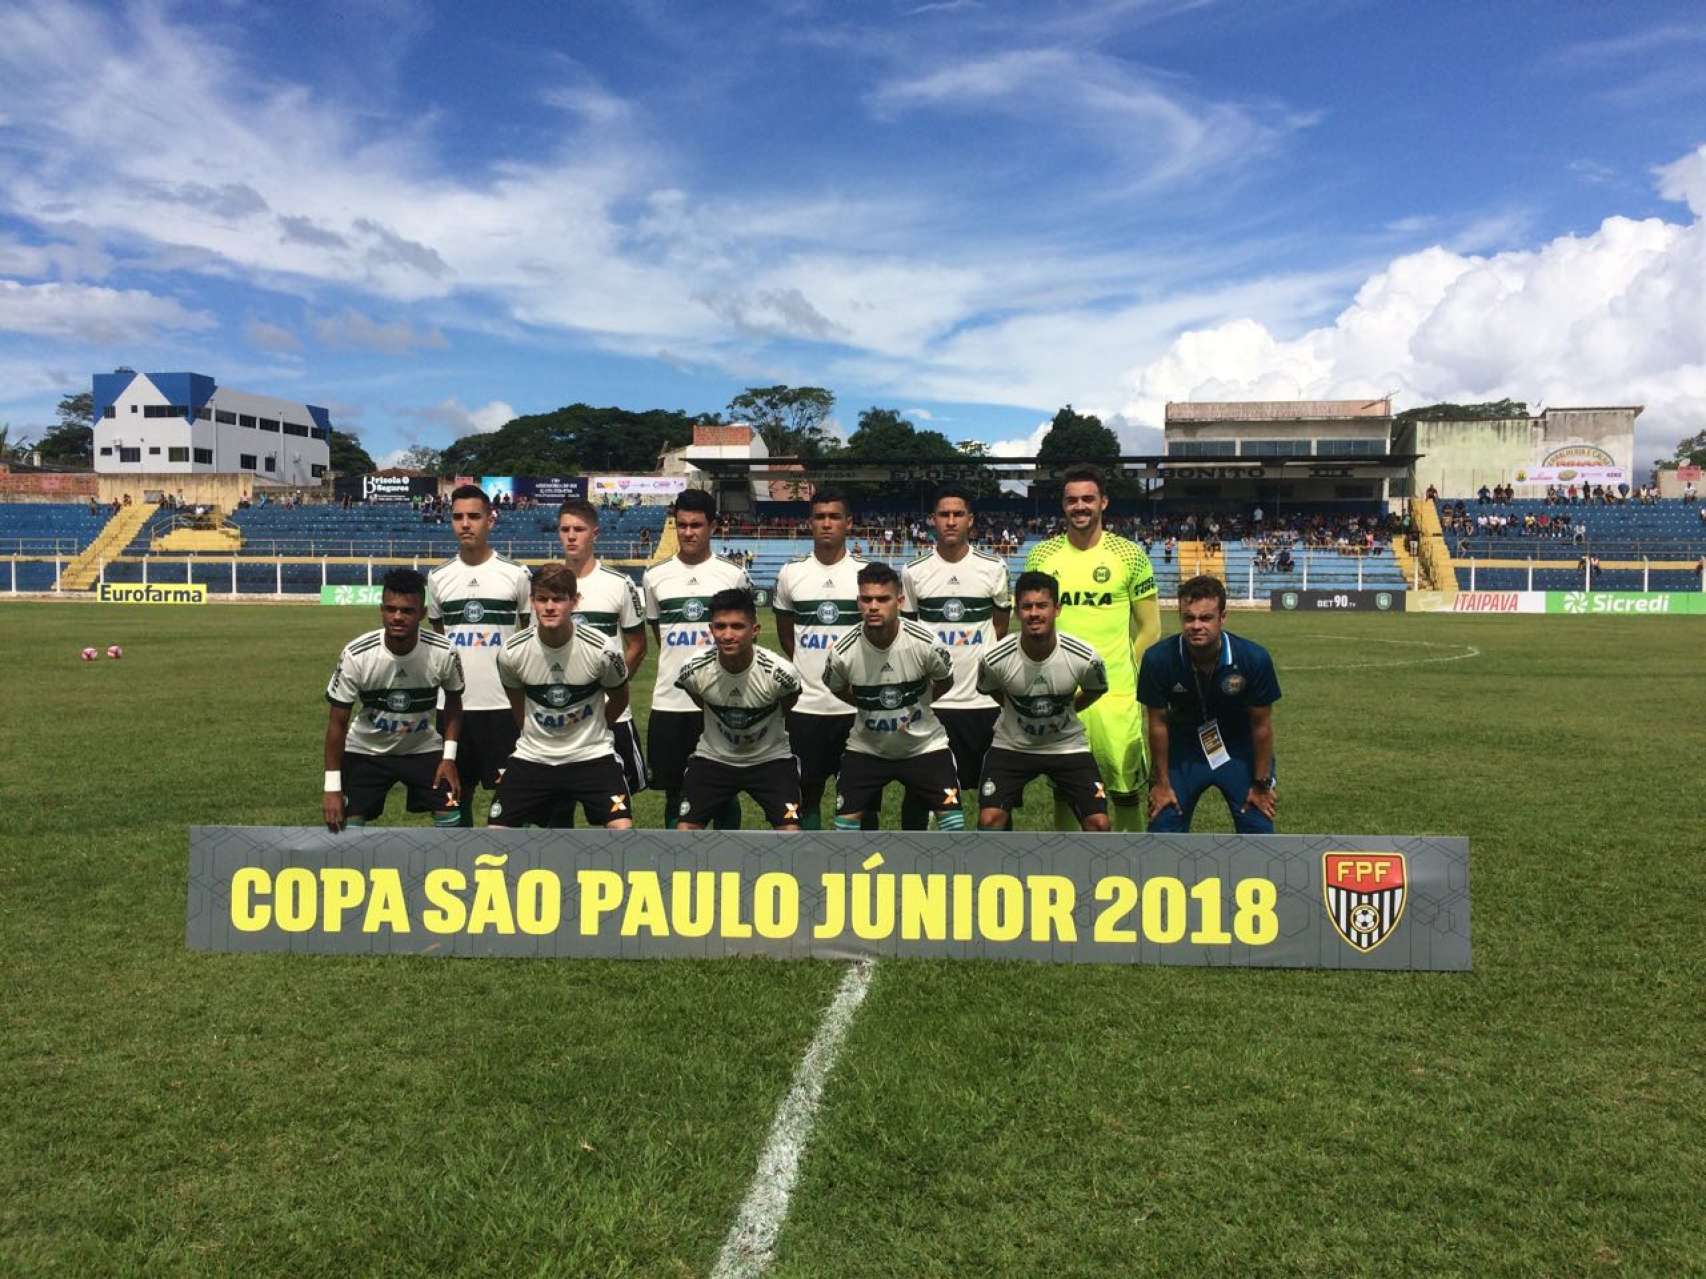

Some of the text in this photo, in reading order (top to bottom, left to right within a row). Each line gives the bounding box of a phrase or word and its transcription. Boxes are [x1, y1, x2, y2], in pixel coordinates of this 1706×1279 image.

[1158, 467, 1265, 479] BONITO
[100, 585, 202, 603] Eurofarma
[1061, 592, 1113, 606] AIXA
[1453, 593, 1519, 611] ITAIPAVA
[1593, 593, 1670, 612] Sicredi
[534, 704, 594, 728] CAIXA
[1337, 860, 1392, 882] FPF
[231, 852, 1280, 946] COPA SÃO PAULO JÚNIOR 2018
